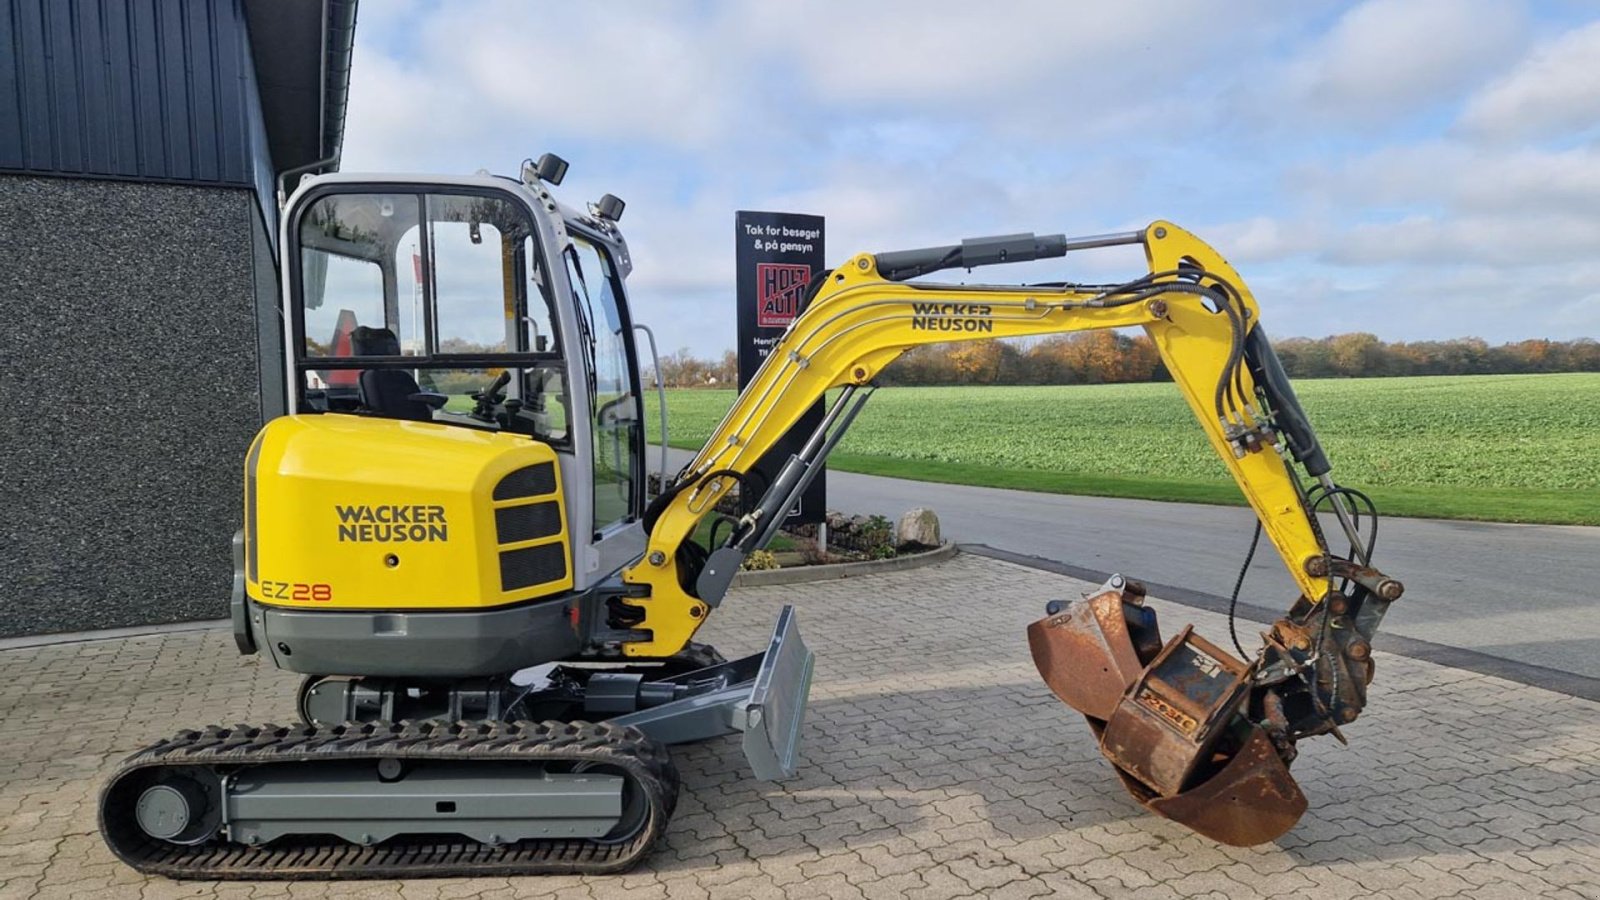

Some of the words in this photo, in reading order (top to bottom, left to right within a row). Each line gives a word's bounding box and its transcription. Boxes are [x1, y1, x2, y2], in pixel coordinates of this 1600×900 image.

[745, 224, 764, 236] Tak
[766, 225, 781, 236] for
[782, 226, 821, 240] besøget
[754, 239, 763, 250] &
[765, 240, 778, 252] på
[780, 242, 813, 254] gensyn
[765, 267, 805, 299] HOLT
[912, 303, 992, 316] WACKER
[912, 316, 993, 332] NEUSON
[335, 505, 447, 523] WACKER
[338, 524, 448, 543] NEUSON
[261, 581, 332, 602] EZ28
